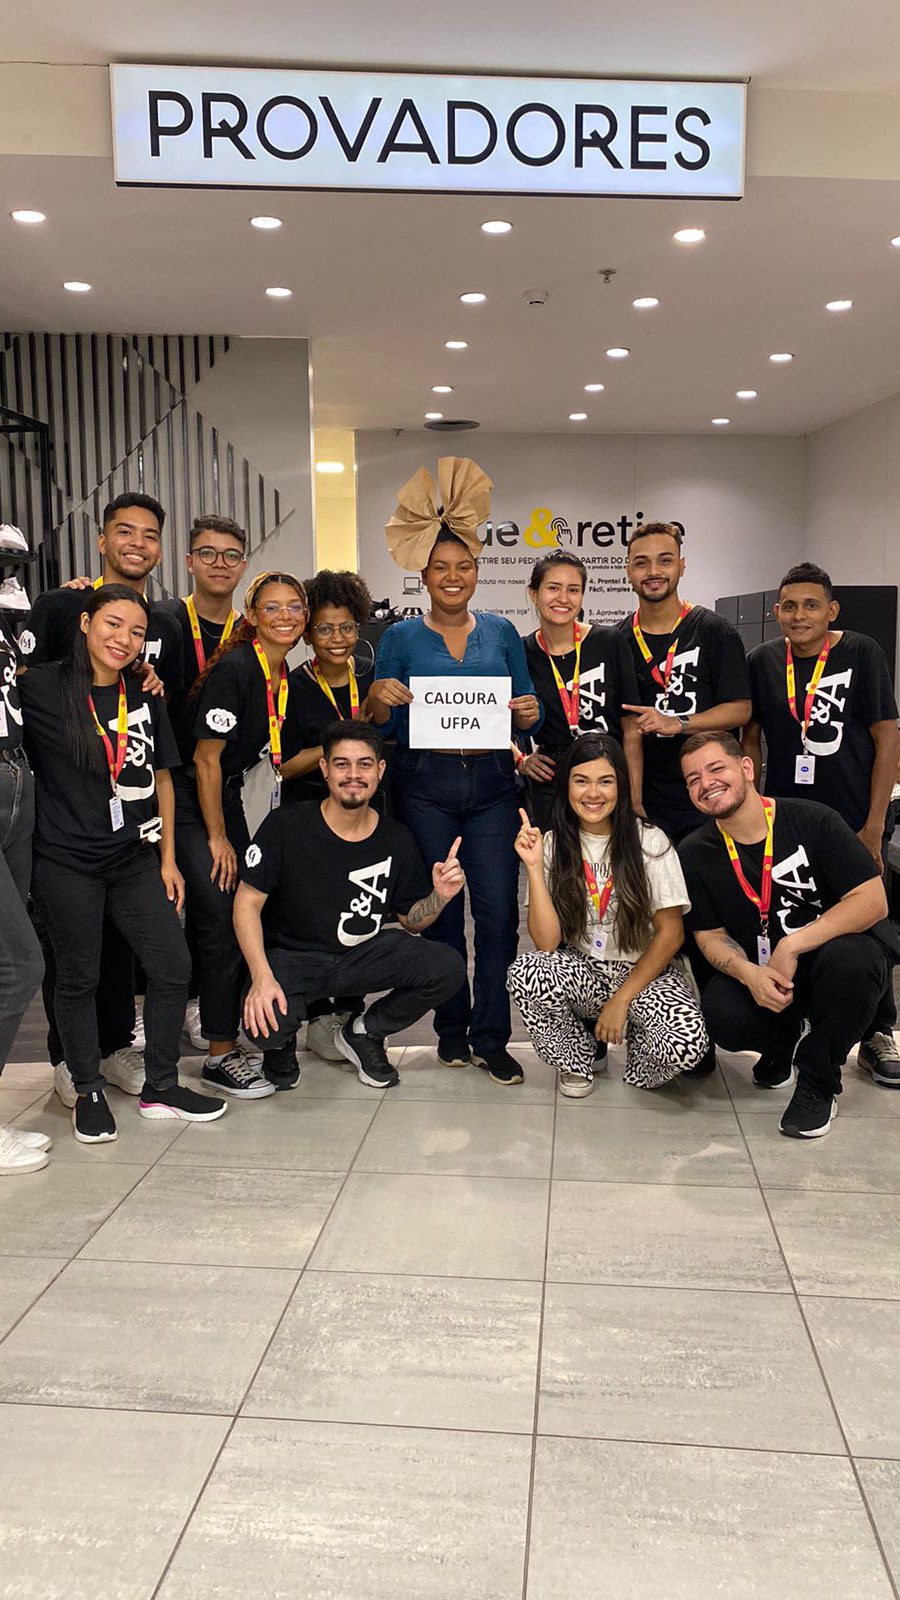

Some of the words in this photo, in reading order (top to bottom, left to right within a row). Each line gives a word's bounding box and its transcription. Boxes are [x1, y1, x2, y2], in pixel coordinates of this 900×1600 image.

[148, 90, 712, 171] PROVADORES
[424, 692, 497, 705] CALOURA
[441, 717, 480, 729] UFPA
[337, 856, 392, 947] C&A
